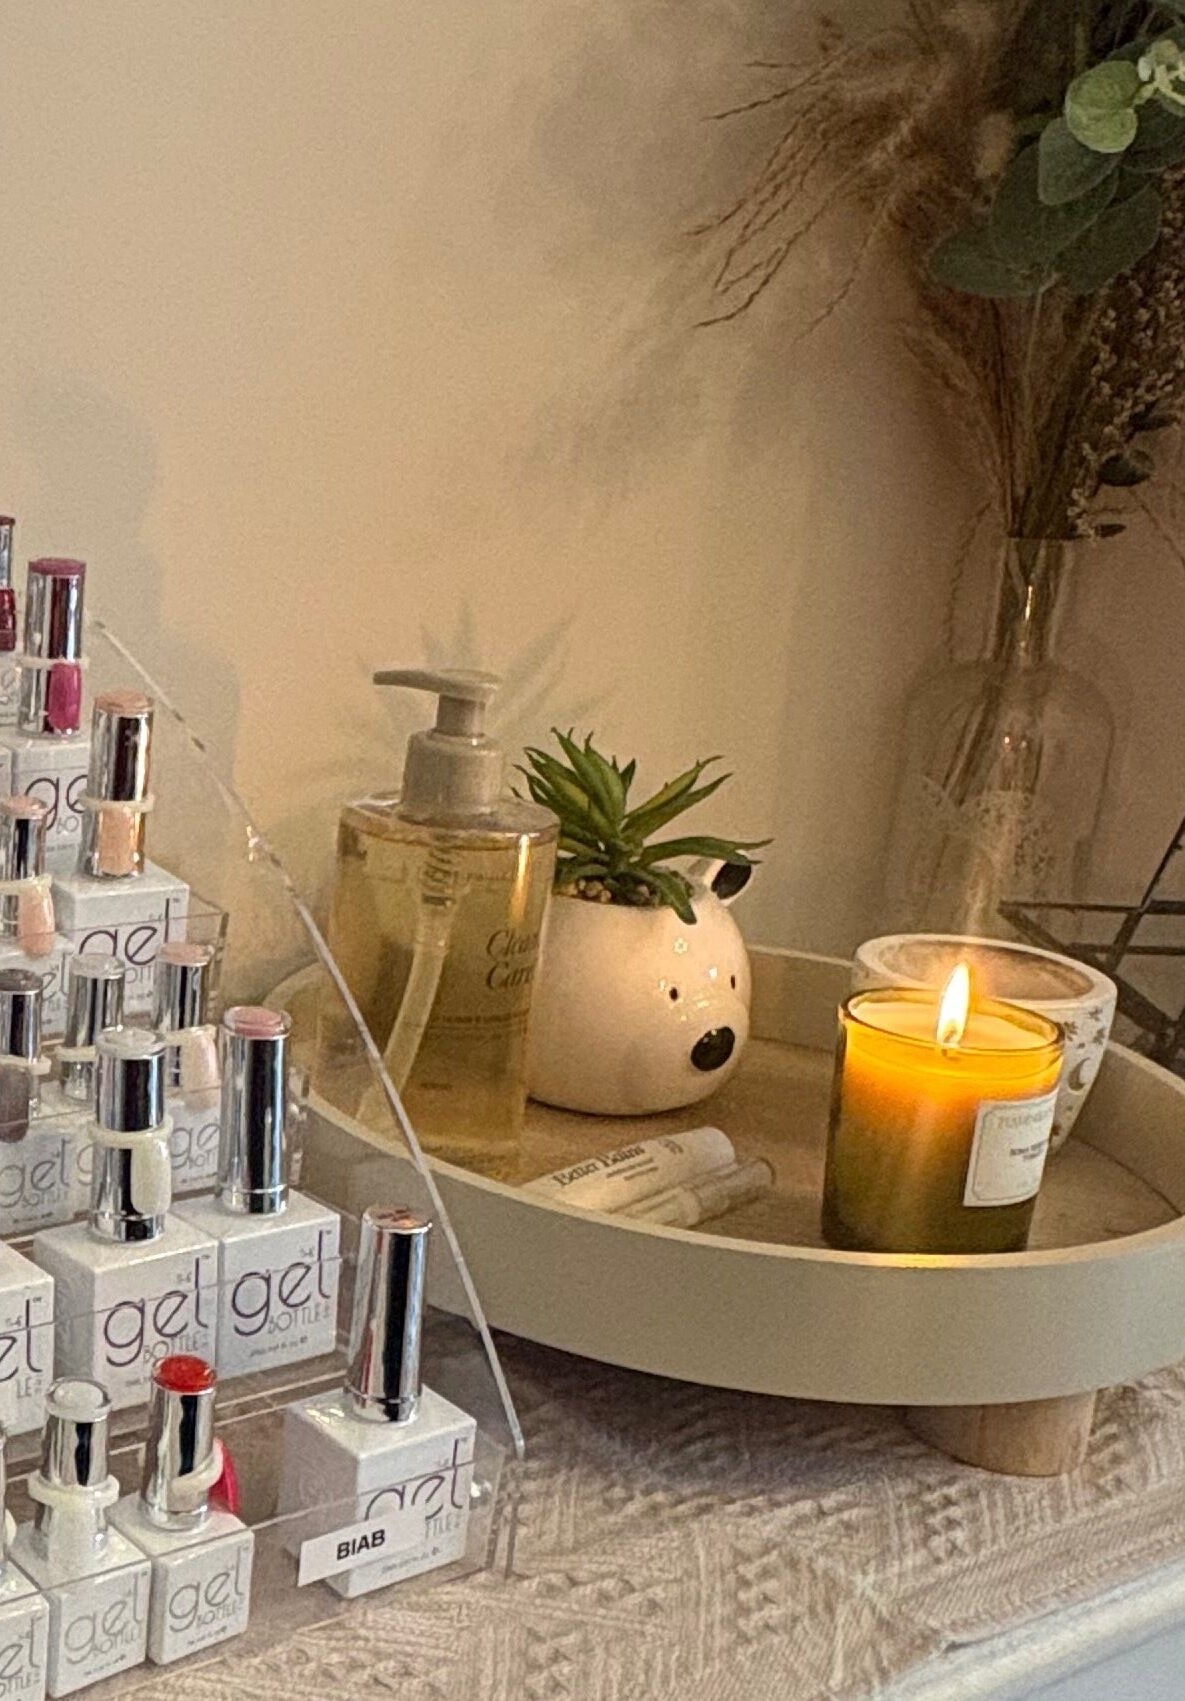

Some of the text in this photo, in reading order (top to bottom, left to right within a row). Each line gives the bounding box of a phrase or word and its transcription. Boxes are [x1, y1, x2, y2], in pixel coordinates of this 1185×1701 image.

[24, 774, 88, 831] ge
[104, 1257, 209, 1368] gel
[231, 1229, 332, 1337] gel
[168, 1546, 245, 1633] gel
[336, 1529, 386, 1561] BIAB
[65, 1572, 142, 1665] gel
